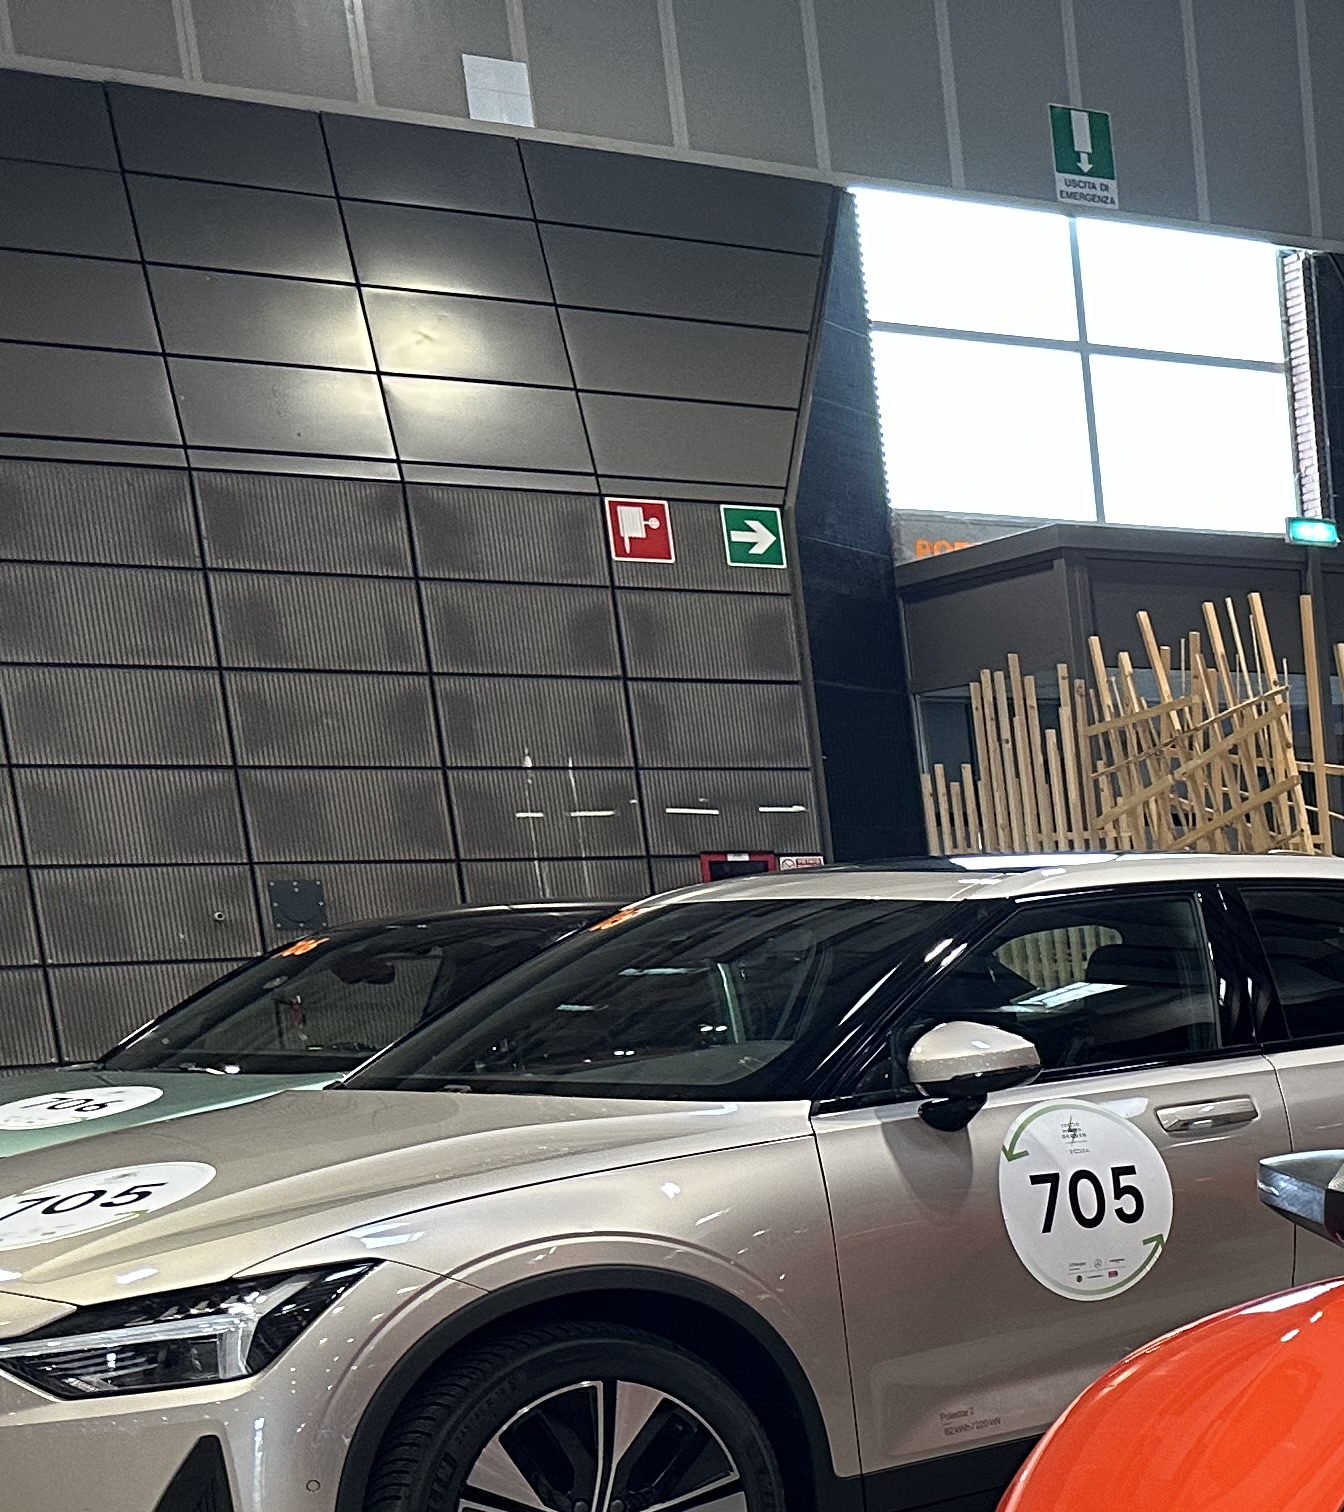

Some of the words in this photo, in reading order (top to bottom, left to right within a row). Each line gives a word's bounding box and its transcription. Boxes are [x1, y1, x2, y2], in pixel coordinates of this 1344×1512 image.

[1064, 179, 1097, 191] USCITA
[1099, 183, 1110, 192] DI
[1059, 190, 1116, 205] EMERGENZA
[20, 1097, 124, 1113] 706
[0, 1182, 168, 1221] 705
[1029, 1165, 1145, 1234] 705
